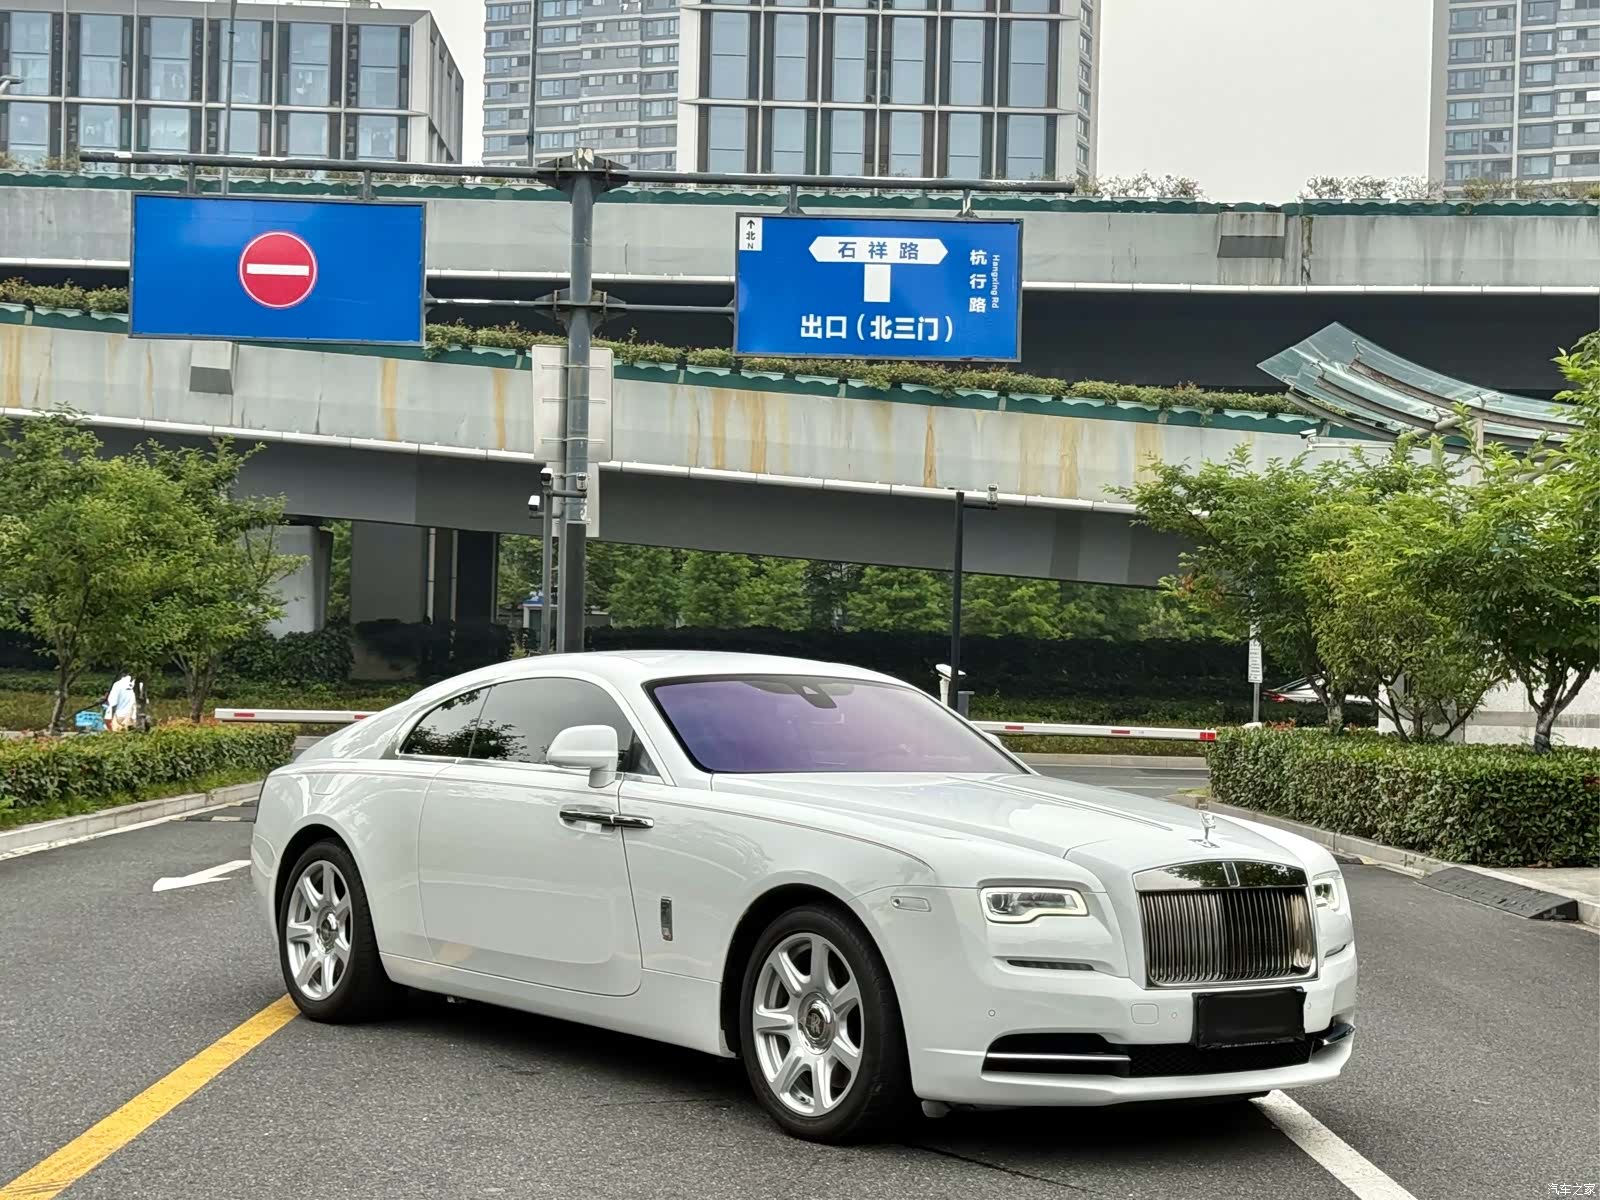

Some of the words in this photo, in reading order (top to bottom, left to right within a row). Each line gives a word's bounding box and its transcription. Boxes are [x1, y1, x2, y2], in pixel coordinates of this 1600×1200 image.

[746, 231, 755, 240] 北
[838, 241, 919, 260] 石祥路
[969, 249, 987, 313] 杭行路
[990, 254, 1000, 296] Hangxing
[991, 297, 1000, 309] Rd
[800, 313, 953, 343] 出口（北三门）
